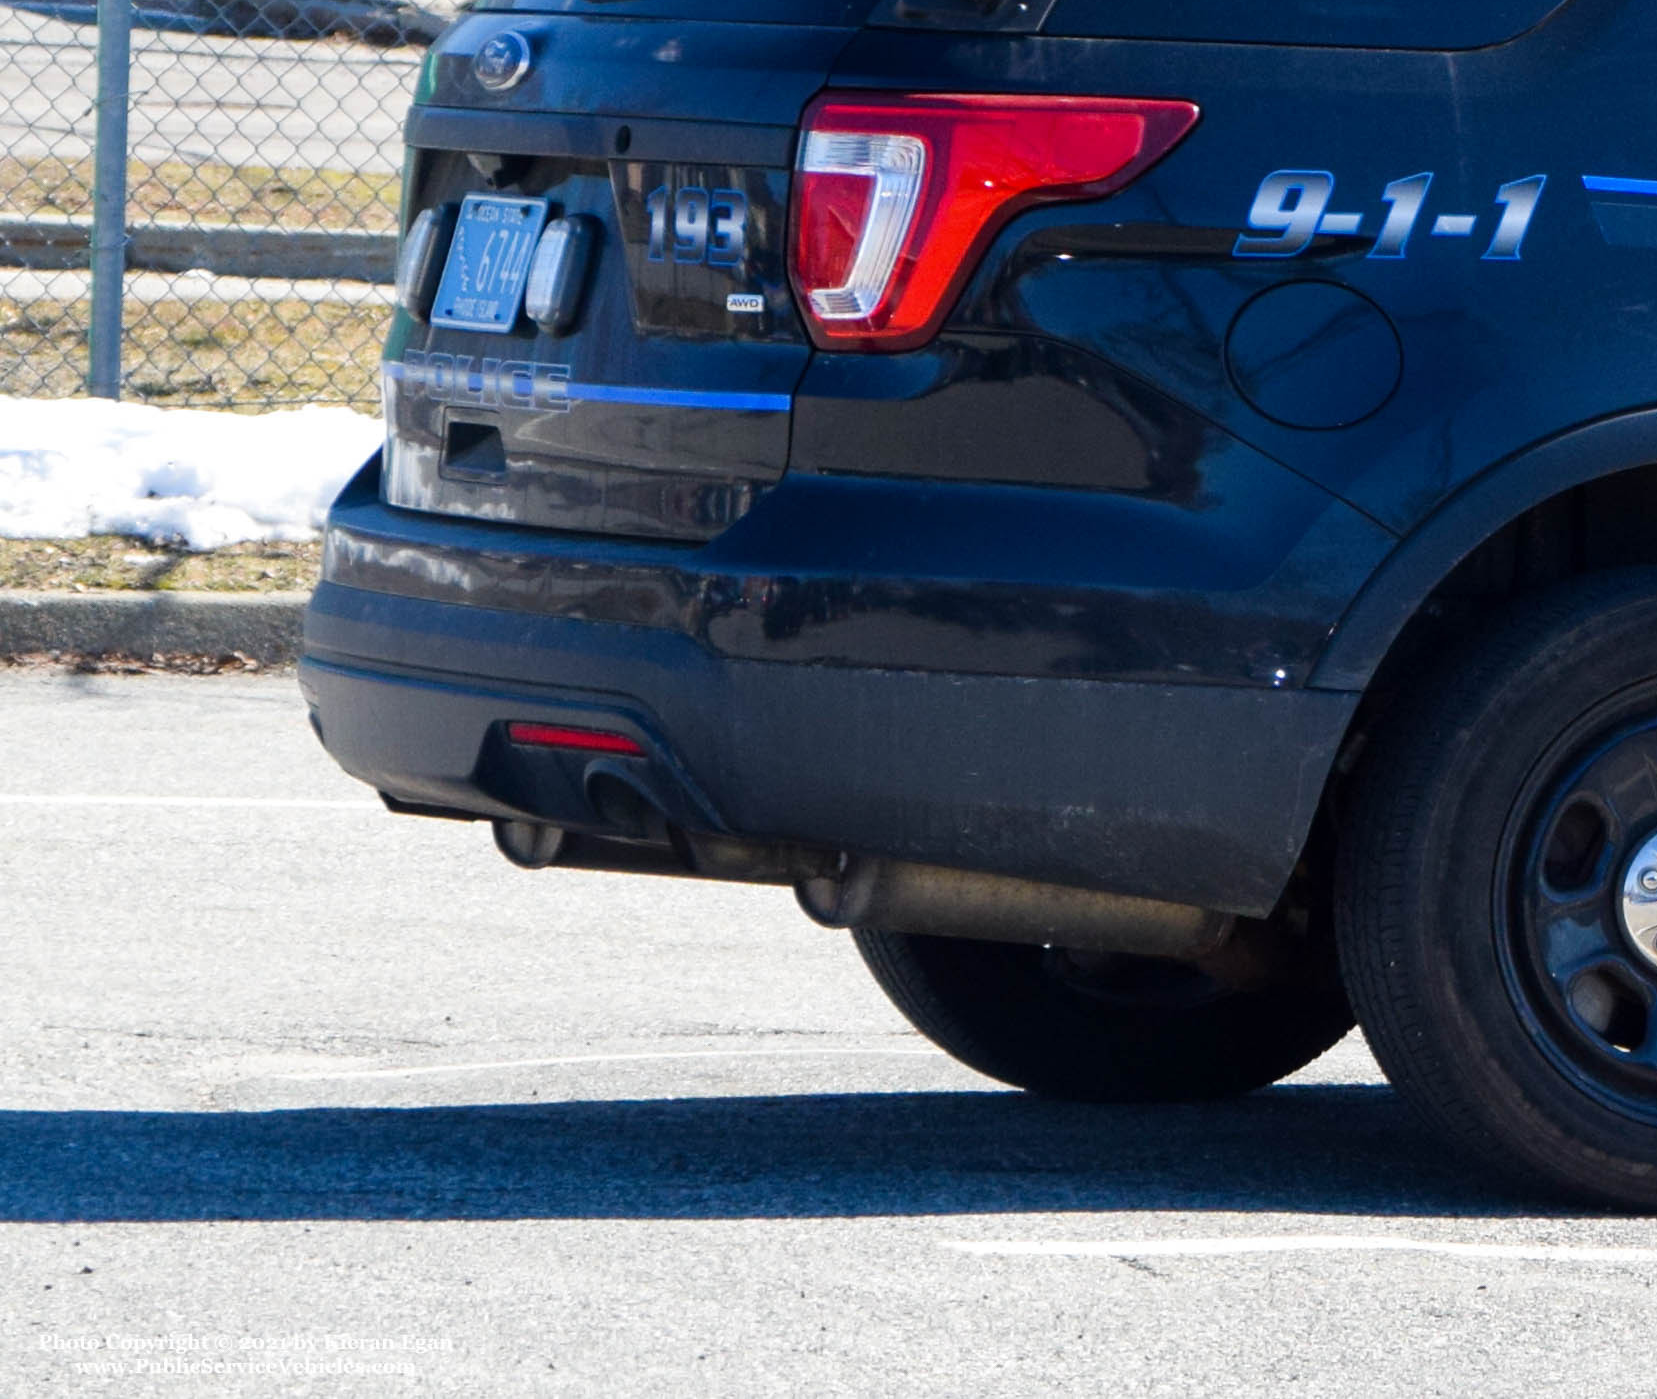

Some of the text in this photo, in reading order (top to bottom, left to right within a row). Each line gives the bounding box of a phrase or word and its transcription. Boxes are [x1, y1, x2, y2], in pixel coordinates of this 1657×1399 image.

[646, 185, 746, 267] 193
[1232, 169, 1547, 260] 9-1-1
[476, 229, 532, 295] 6744
[728, 297, 760, 309] AWD
[403, 348, 571, 414] POLICE
